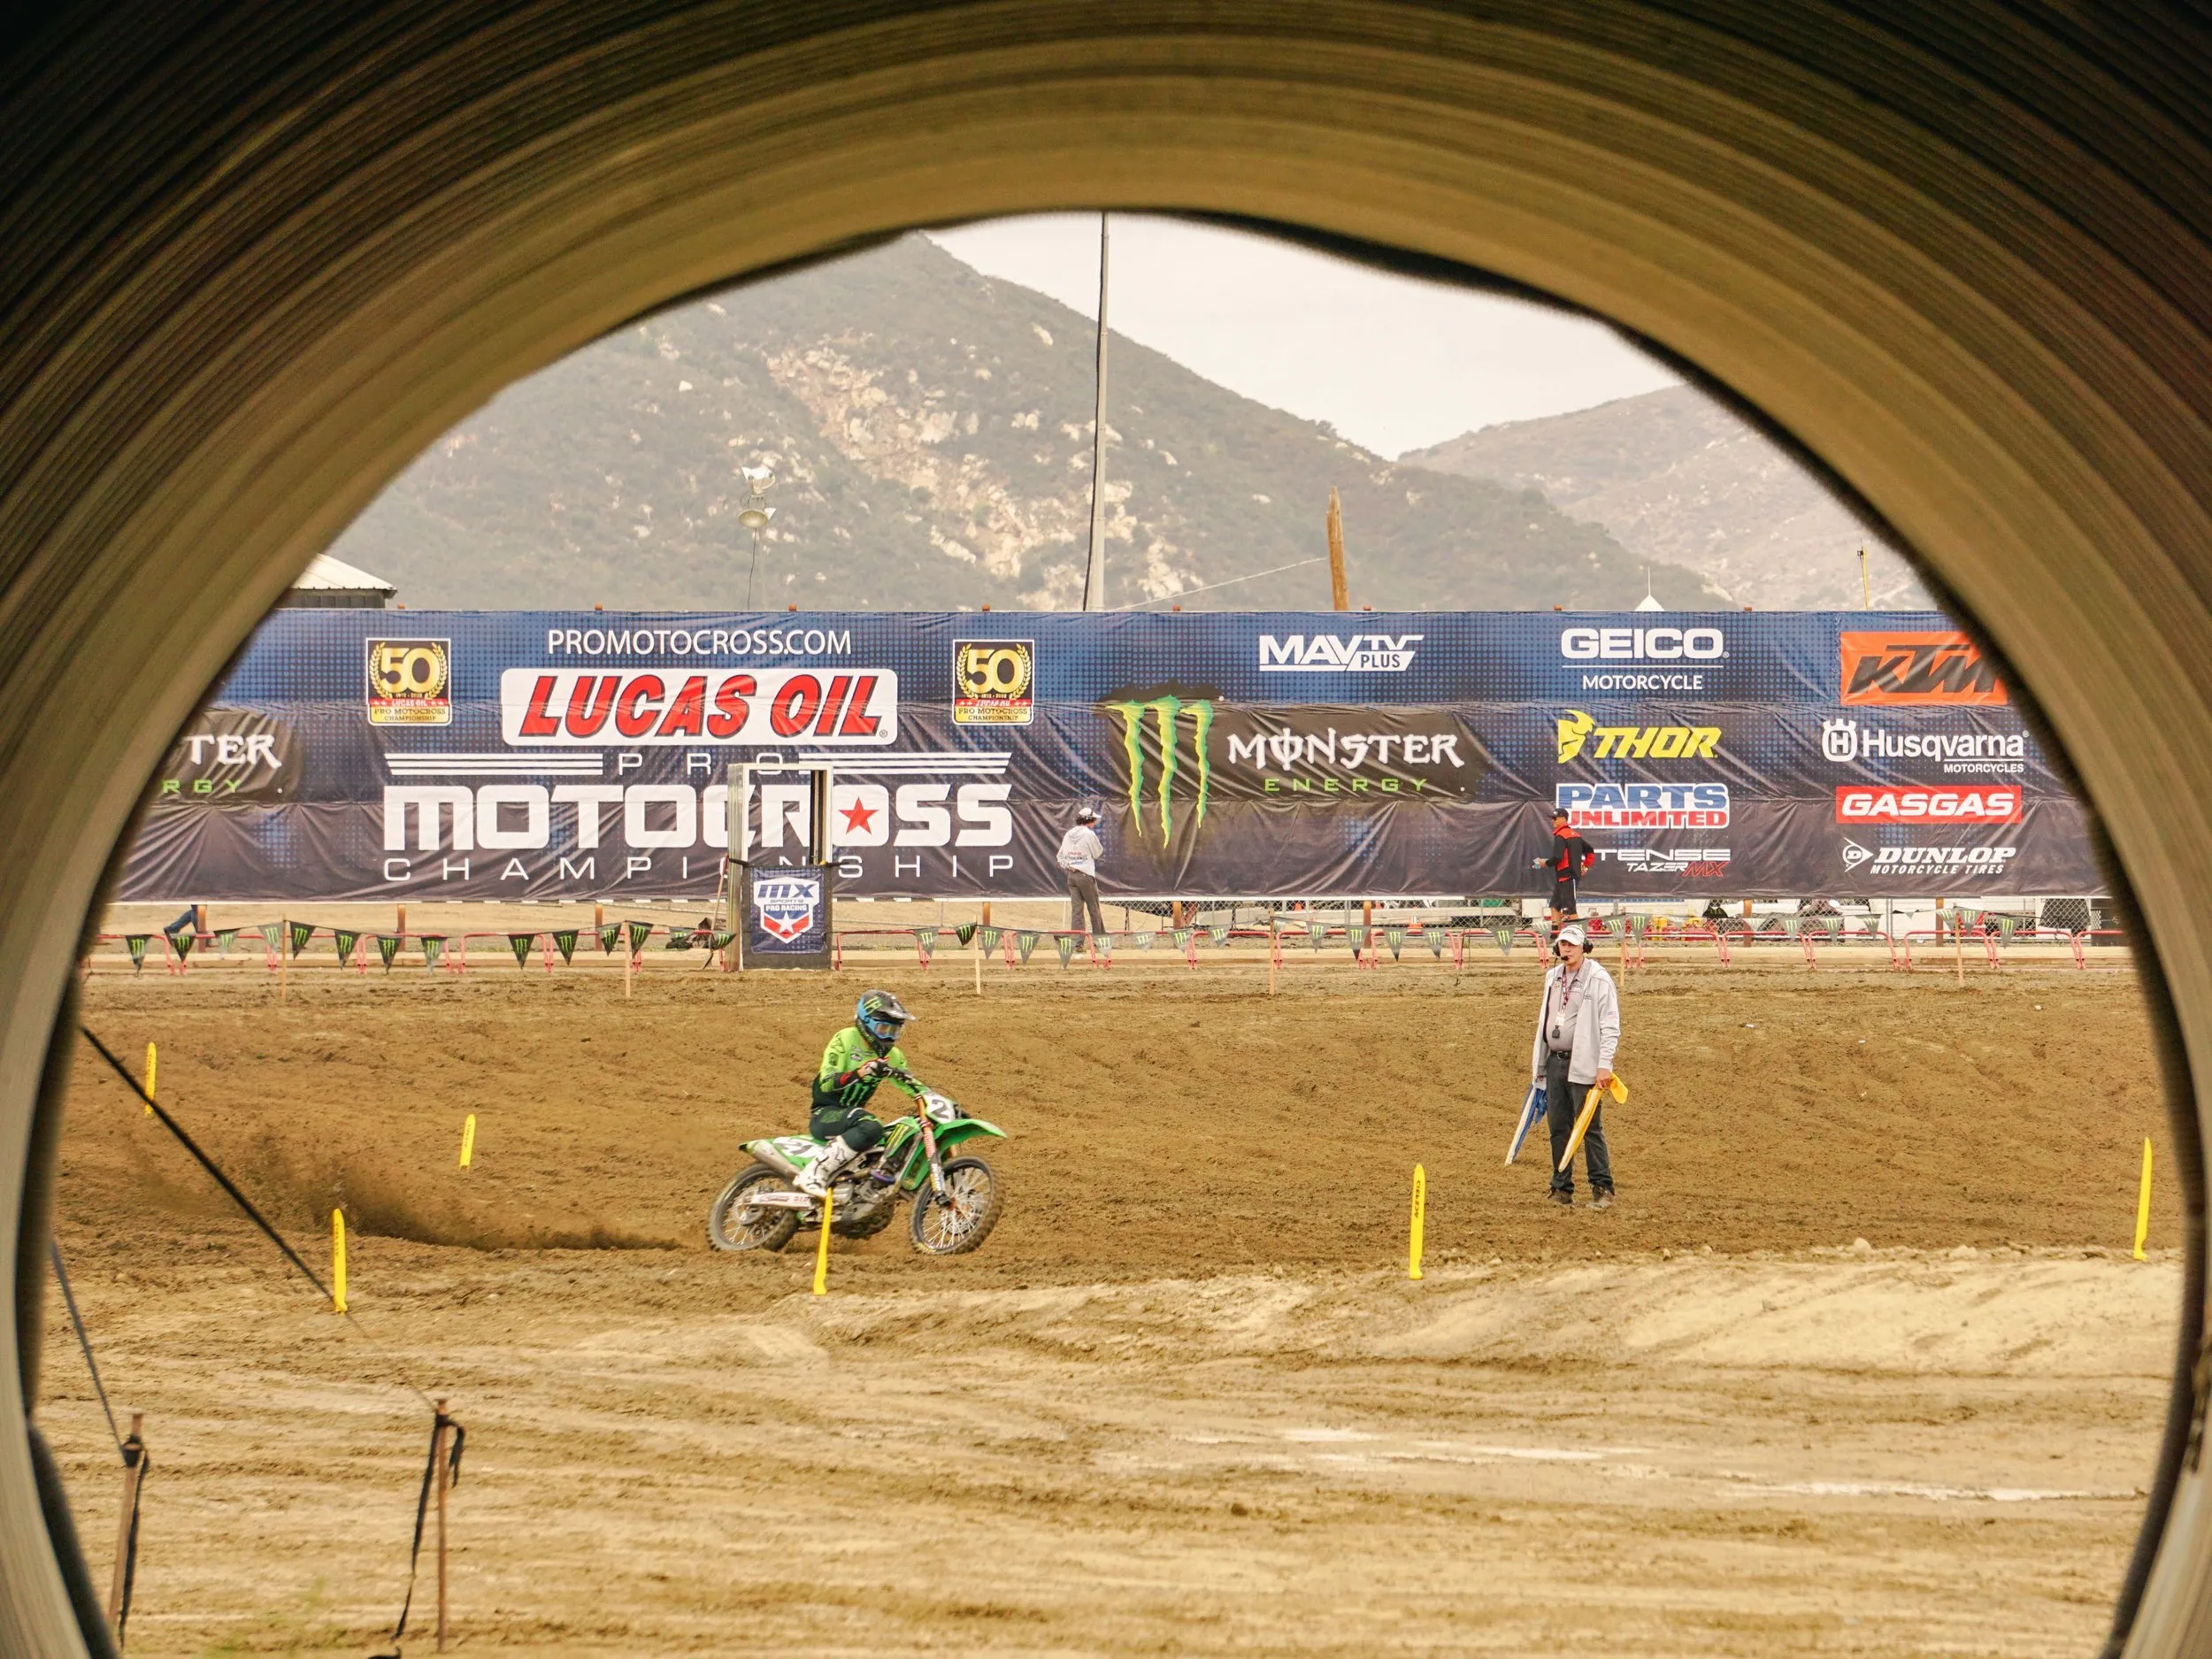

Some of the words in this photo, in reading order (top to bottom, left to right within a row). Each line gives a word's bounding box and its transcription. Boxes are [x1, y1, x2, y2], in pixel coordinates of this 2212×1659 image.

[548, 629, 851, 655] PROMOTOCROSS.COM
[1561, 627, 1724, 659] GEICO
[380, 647, 441, 694] 50
[965, 649, 1024, 694] 50
[1360, 654, 1401, 668] PLUS
[1847, 644, 1998, 694] KTM
[1582, 675, 1702, 690] MOTORCYCLE
[518, 674, 757, 738] LUCAS
[770, 674, 882, 738] OIL
[1594, 727, 1722, 758] THOR
[1863, 729, 2024, 762] Husqvarna
[618, 752, 783, 775] PRO
[1944, 764, 2024, 773] MOTORCYCLES
[1264, 778, 1427, 792] ENERGY
[1558, 786, 1727, 810] PARTS
[1841, 793, 2015, 817] GASGAS
[383, 784, 1012, 851] MOTOCROSS
[1593, 849, 1732, 861] TENSE
[1874, 847, 2016, 864] DUNLOP
[383, 855, 1013, 881] CHAMPISHIP
[1626, 862, 1688, 872] TAZER
[1682, 861, 1730, 877] MX
[1870, 864, 1957, 874] MOTORCYCLE
[1965, 864, 2004, 874] TIRES
[757, 885, 816, 898] MX
